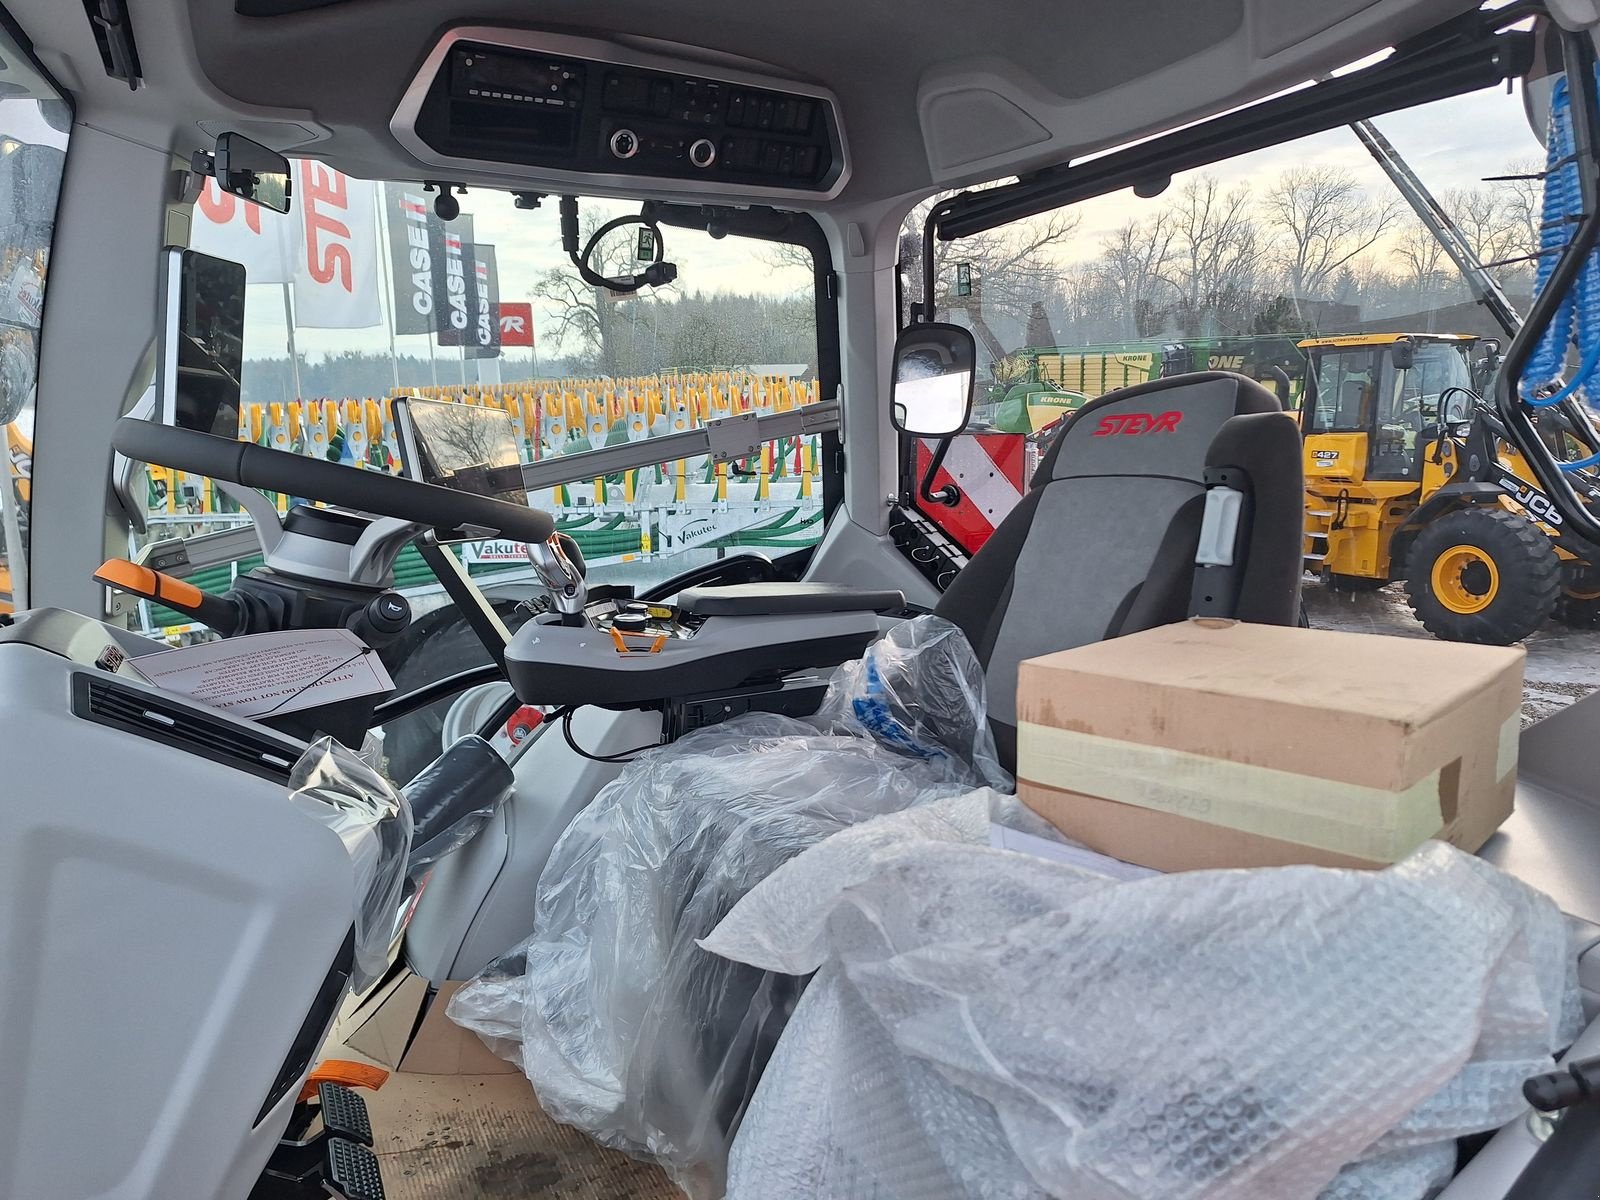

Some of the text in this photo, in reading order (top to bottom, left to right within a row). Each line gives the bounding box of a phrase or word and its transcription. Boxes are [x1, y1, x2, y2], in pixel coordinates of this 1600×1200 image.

[407, 224, 433, 315] CASE
[447, 257, 468, 330] CASE
[476, 282, 491, 345] CASE
[500, 315, 525, 335] R
[1122, 354, 1148, 362] KRONE
[1039, 395, 1074, 405] KRONE
[1093, 411, 1183, 437] STEYR
[677, 524, 718, 545] Vakutec
[236, 696, 258, 705] TOW
[261, 691, 280, 699] NOT
[281, 687, 297, 695] DO
